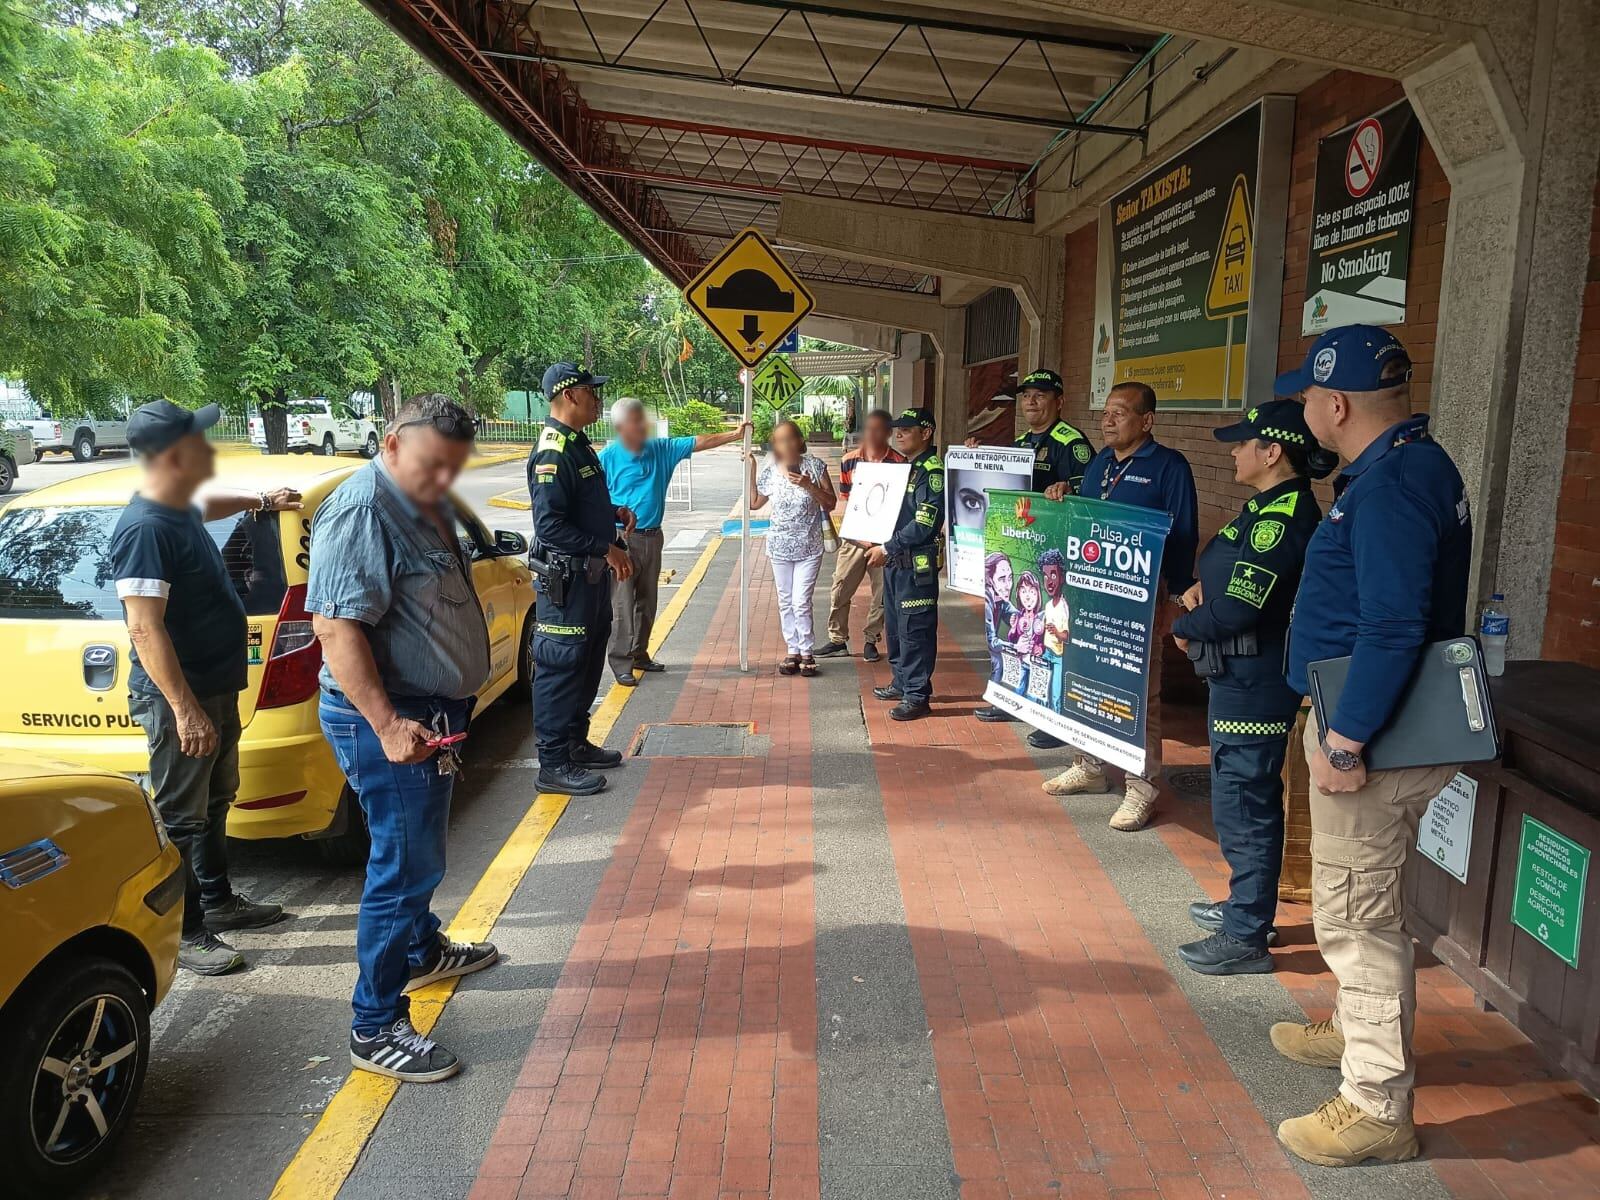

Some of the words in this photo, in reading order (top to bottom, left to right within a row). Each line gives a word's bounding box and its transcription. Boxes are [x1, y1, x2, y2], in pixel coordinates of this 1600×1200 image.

[1116, 198, 1140, 226] Señor
[1140, 165, 1192, 212] TAXISTA:
[1316, 213, 1331, 230] Este
[1332, 210, 1341, 224] es
[1342, 206, 1353, 220] un
[1354, 190, 1387, 217] espacio
[1387, 181, 1411, 205] 100%
[1313, 232, 1329, 250] libre
[1330, 230, 1340, 245] de
[1341, 223, 1364, 242] humo
[1365, 219, 1376, 234] de
[1378, 208, 1410, 230] tabaco
[1321, 262, 1336, 284] No
[1338, 248, 1392, 280] Smoking
[1224, 272, 1244, 295] TAXI
[976, 453, 1030, 464] METROPOLITANA
[984, 463, 1004, 471] NEIVA
[1002, 525, 1047, 546] LibertApp
[1090, 523, 1122, 544] Pulsa
[1130, 531, 1143, 547] el
[1069, 562, 1074, 570] y
[1074, 562, 1107, 576] ayúdanos
[1114, 570, 1142, 582] combatir
[1142, 576, 1150, 585] la
[1068, 574, 1091, 587] TRATA
[1092, 580, 1104, 589] DE
[1105, 582, 1144, 599] PERSONAS
[1258, 585, 1265, 594] Y
[1079, 608, 1088, 617] Se
[1089, 612, 1110, 622] estima
[1111, 616, 1122, 627] que
[1124, 618, 1130, 628] el
[1075, 618, 1083, 627] de
[1084, 620, 1094, 629] las
[1095, 623, 1120, 636] víctimas
[1121, 628, 1129, 638] de
[1130, 632, 1144, 643] trata
[1094, 633, 1103, 641] de
[1103, 636, 1132, 650] personas
[1132, 644, 1144, 653] son
[1095, 655, 1100, 663] y
[21, 713, 101, 728] SERVICIO
[1432, 818, 1446, 833] PAPEL
[1433, 810, 1449, 825] VIDRIO
[1431, 828, 1453, 847] METALES
[1539, 833, 1569, 856] RESIDUOS
[1527, 843, 1578, 879] APROVECHABLES
[1532, 864, 1557, 885] RESTOS
[1558, 880, 1568, 892] DE
[1535, 877, 1560, 898] COMIDA
[1529, 888, 1565, 916] DESECHOS
